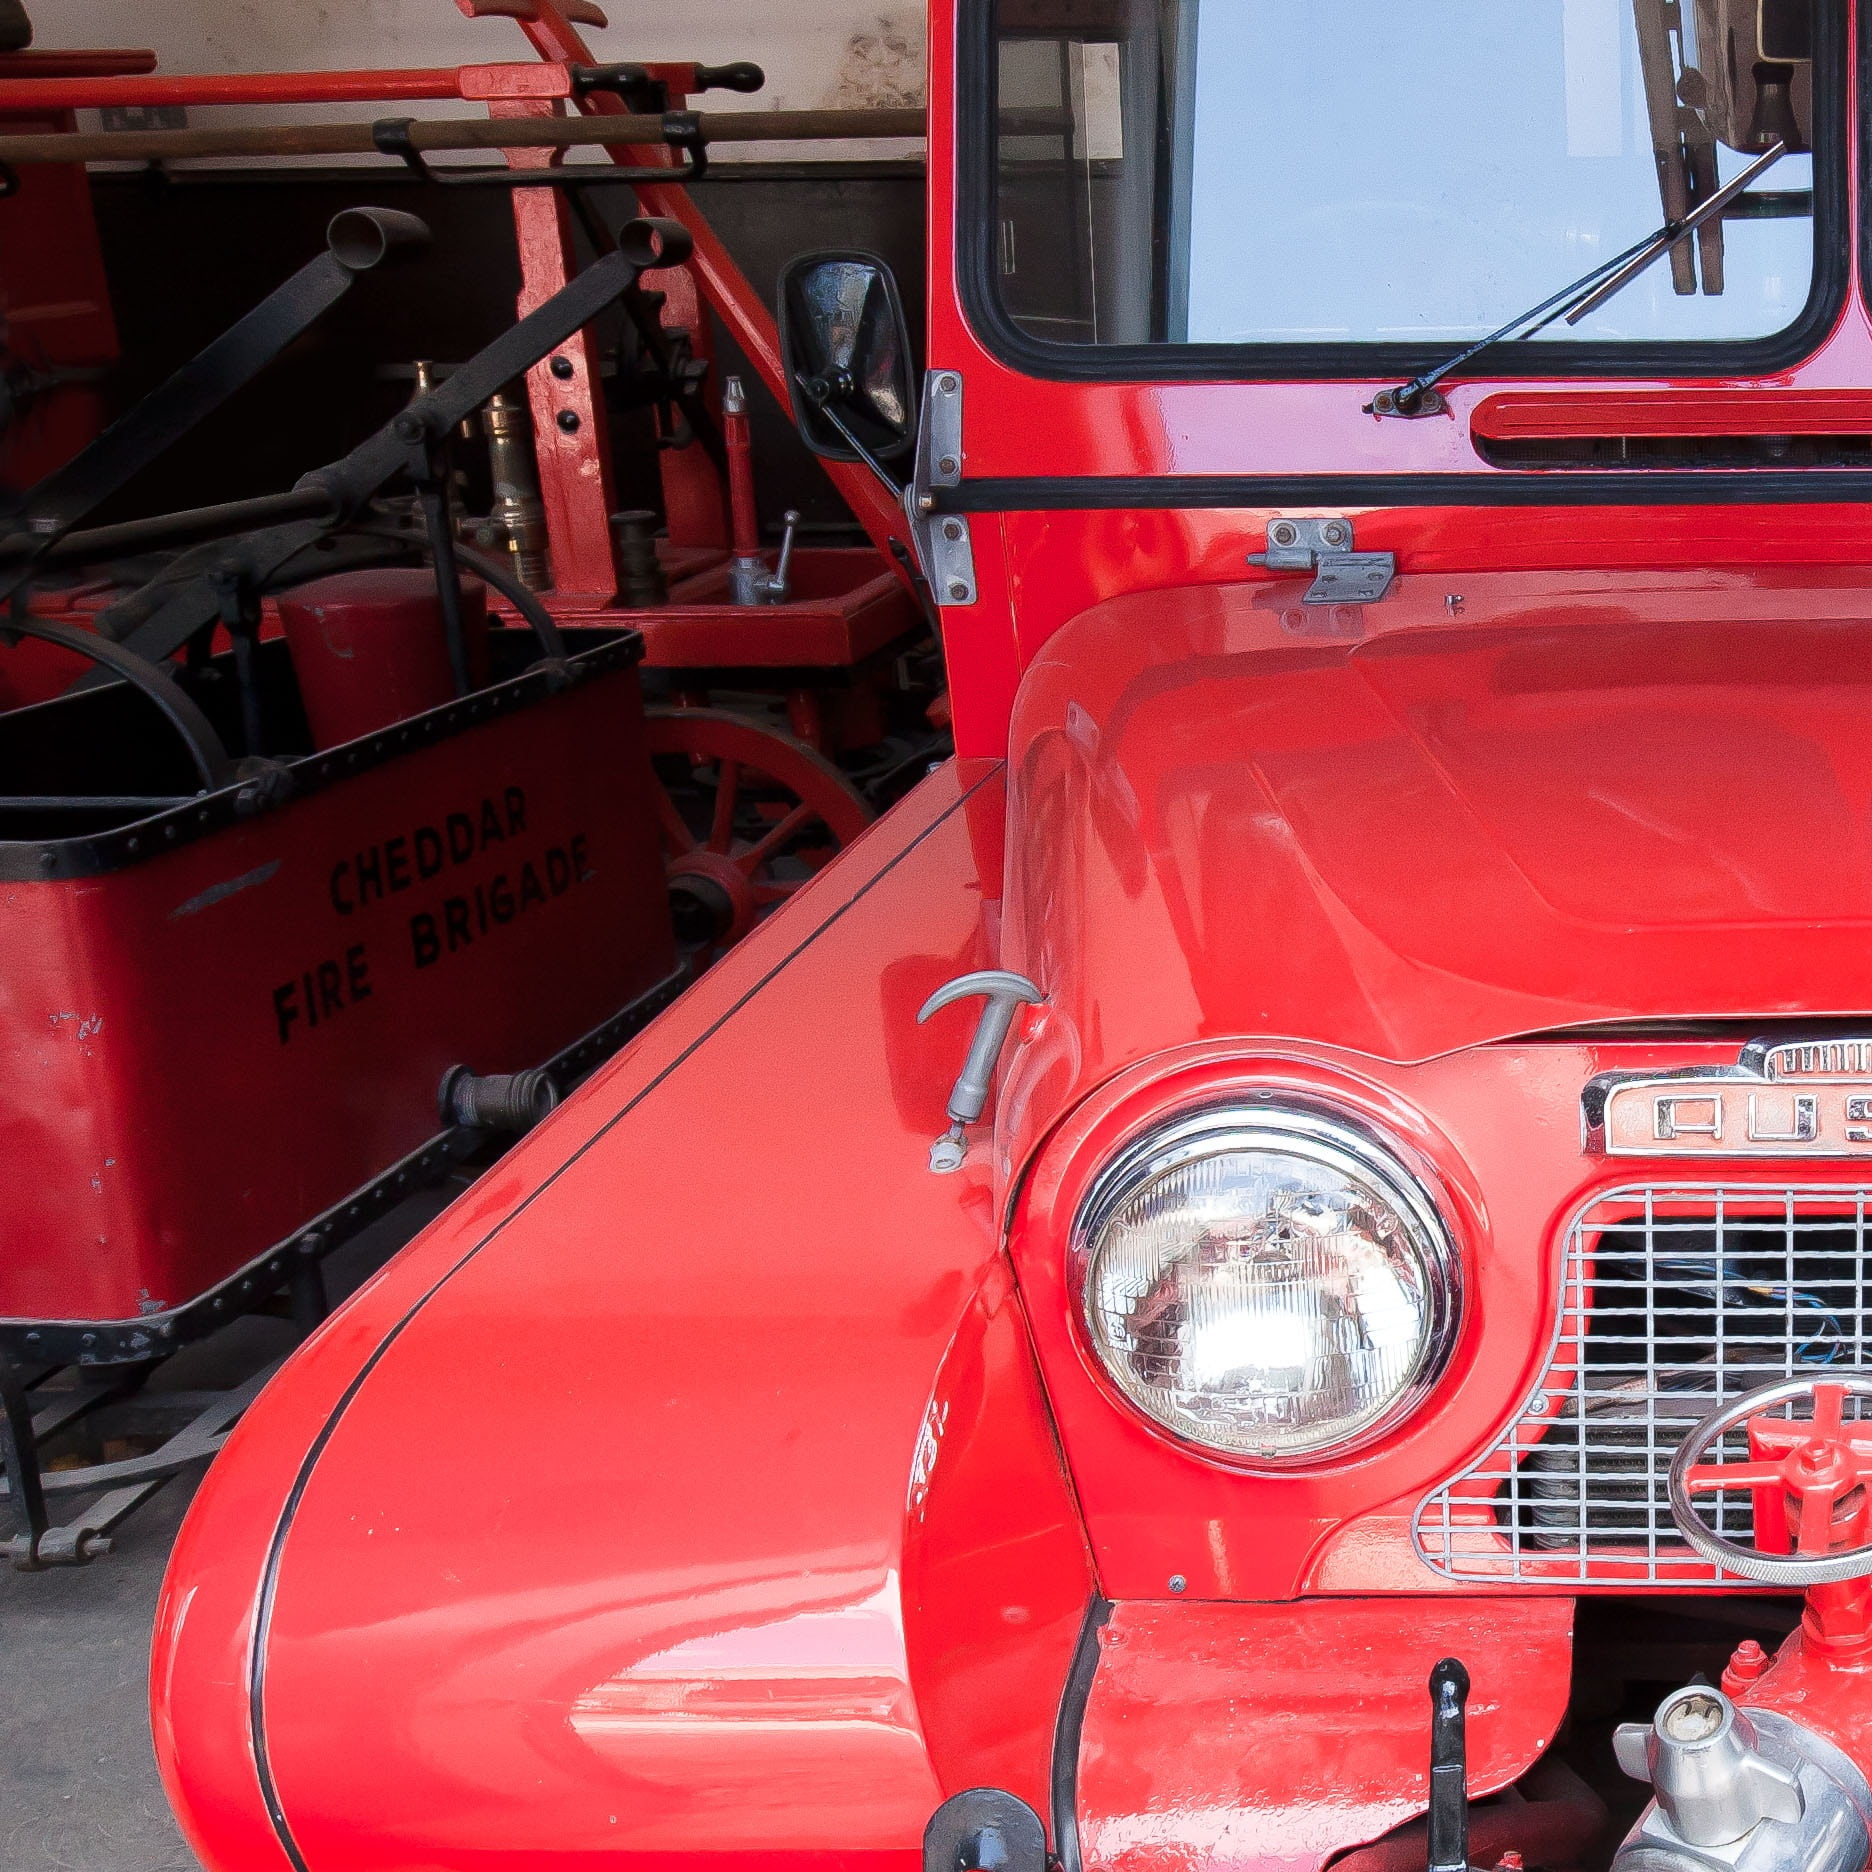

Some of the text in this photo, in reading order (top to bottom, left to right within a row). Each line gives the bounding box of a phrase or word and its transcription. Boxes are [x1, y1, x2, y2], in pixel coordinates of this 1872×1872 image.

[328, 786, 527, 916] CHEDDAR
[272, 832, 590, 1046] FIRE BRIGADE
